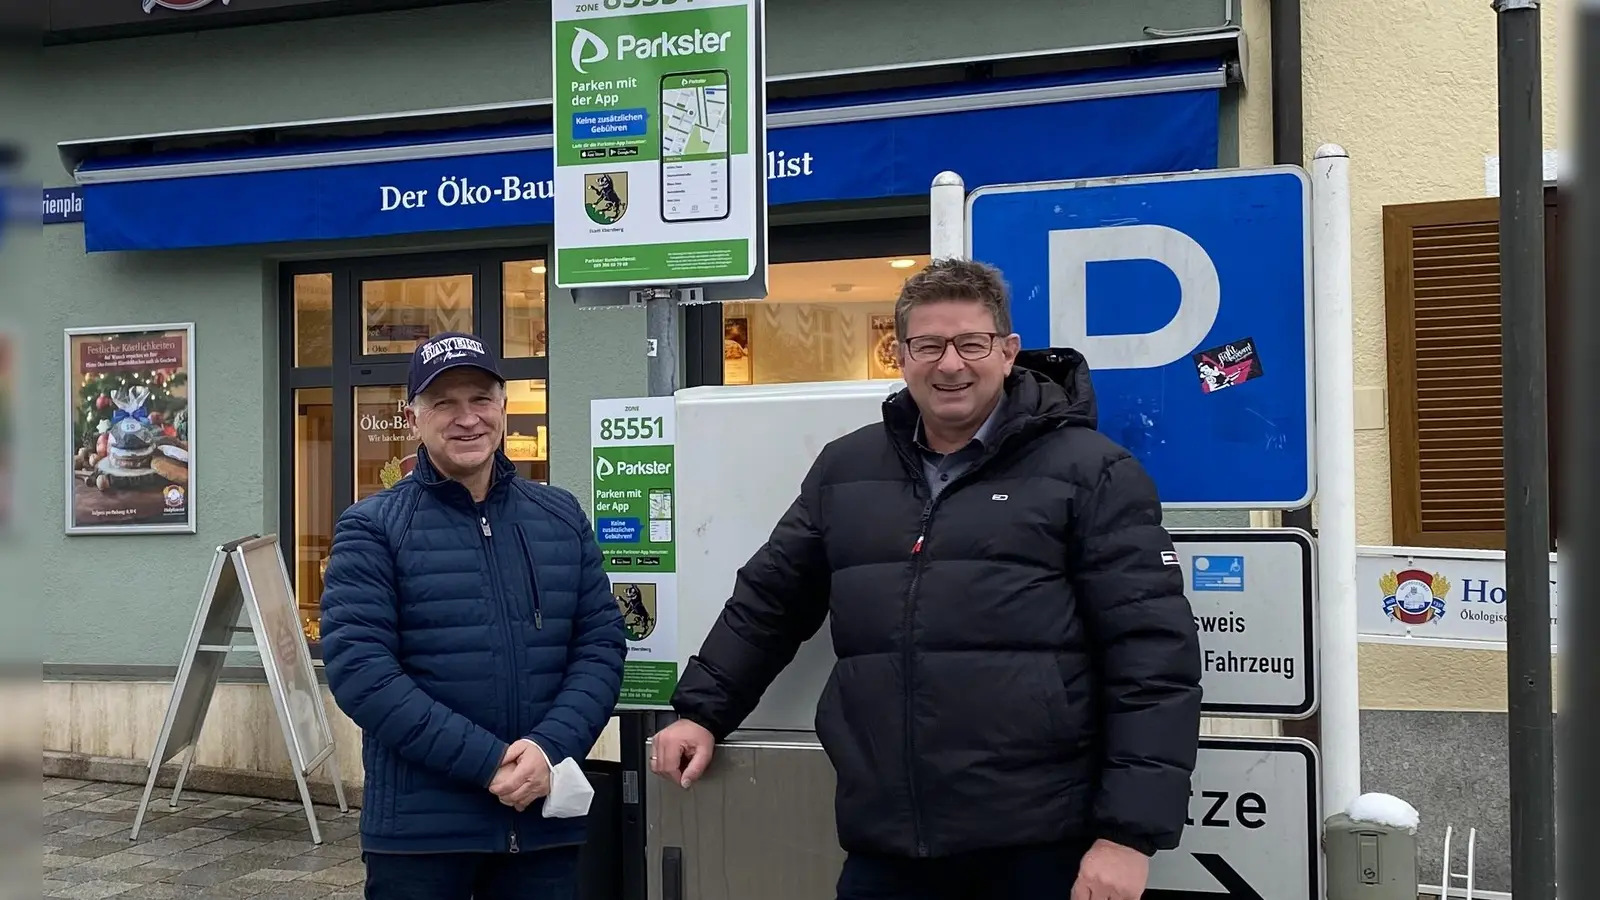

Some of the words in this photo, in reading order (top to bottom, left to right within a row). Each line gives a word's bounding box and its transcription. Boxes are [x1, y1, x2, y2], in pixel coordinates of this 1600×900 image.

[575, 3, 599, 12] ZONE
[617, 29, 731, 61] Parkster
[571, 80, 613, 92] Parken
[616, 77, 637, 89] mit
[571, 95, 592, 106] der
[595, 94, 619, 106] App
[380, 186, 428, 211] Der
[767, 150, 813, 180] list
[42, 192, 84, 218] rienpla
[1048, 224, 1221, 370] P
[87, 343, 119, 355] Festliche
[122, 340, 176, 352] Köstlichkeiten
[600, 416, 663, 440] 85551
[617, 461, 671, 475] Parkster
[596, 489, 624, 499] Parken
[626, 489, 642, 498] mit
[596, 502, 610, 511] der
[611, 502, 629, 512] App
[1204, 650, 1294, 679] Fahrzeug
